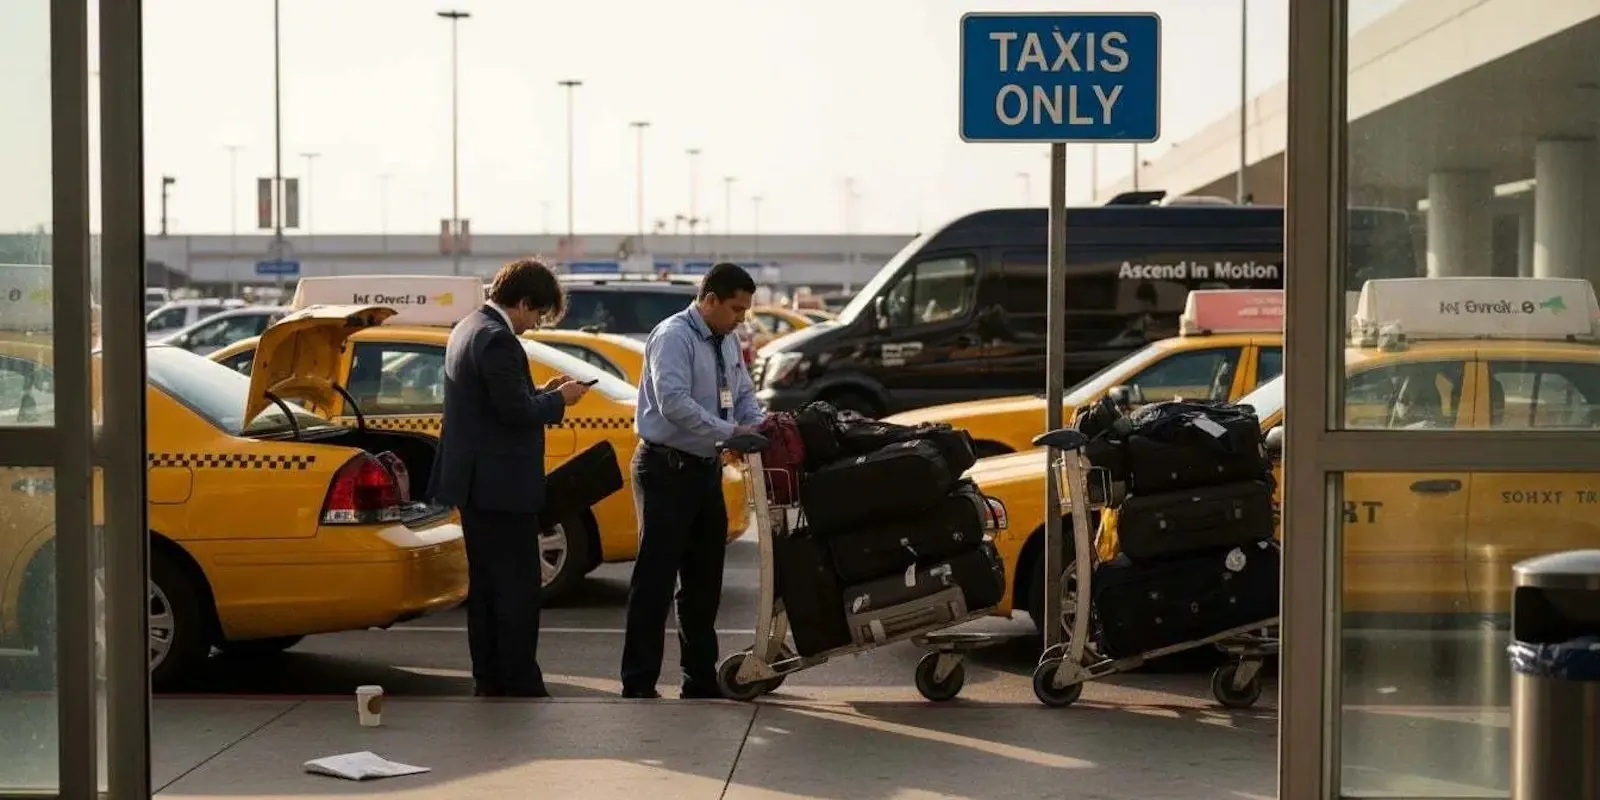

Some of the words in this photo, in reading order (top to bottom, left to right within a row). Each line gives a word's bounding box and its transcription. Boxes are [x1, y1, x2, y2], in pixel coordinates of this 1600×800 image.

[989, 31, 1130, 73] TAXIS
[995, 84, 1124, 126] ONLY
[1118, 261, 1187, 279] Ascend
[1213, 261, 1279, 279] Motion
